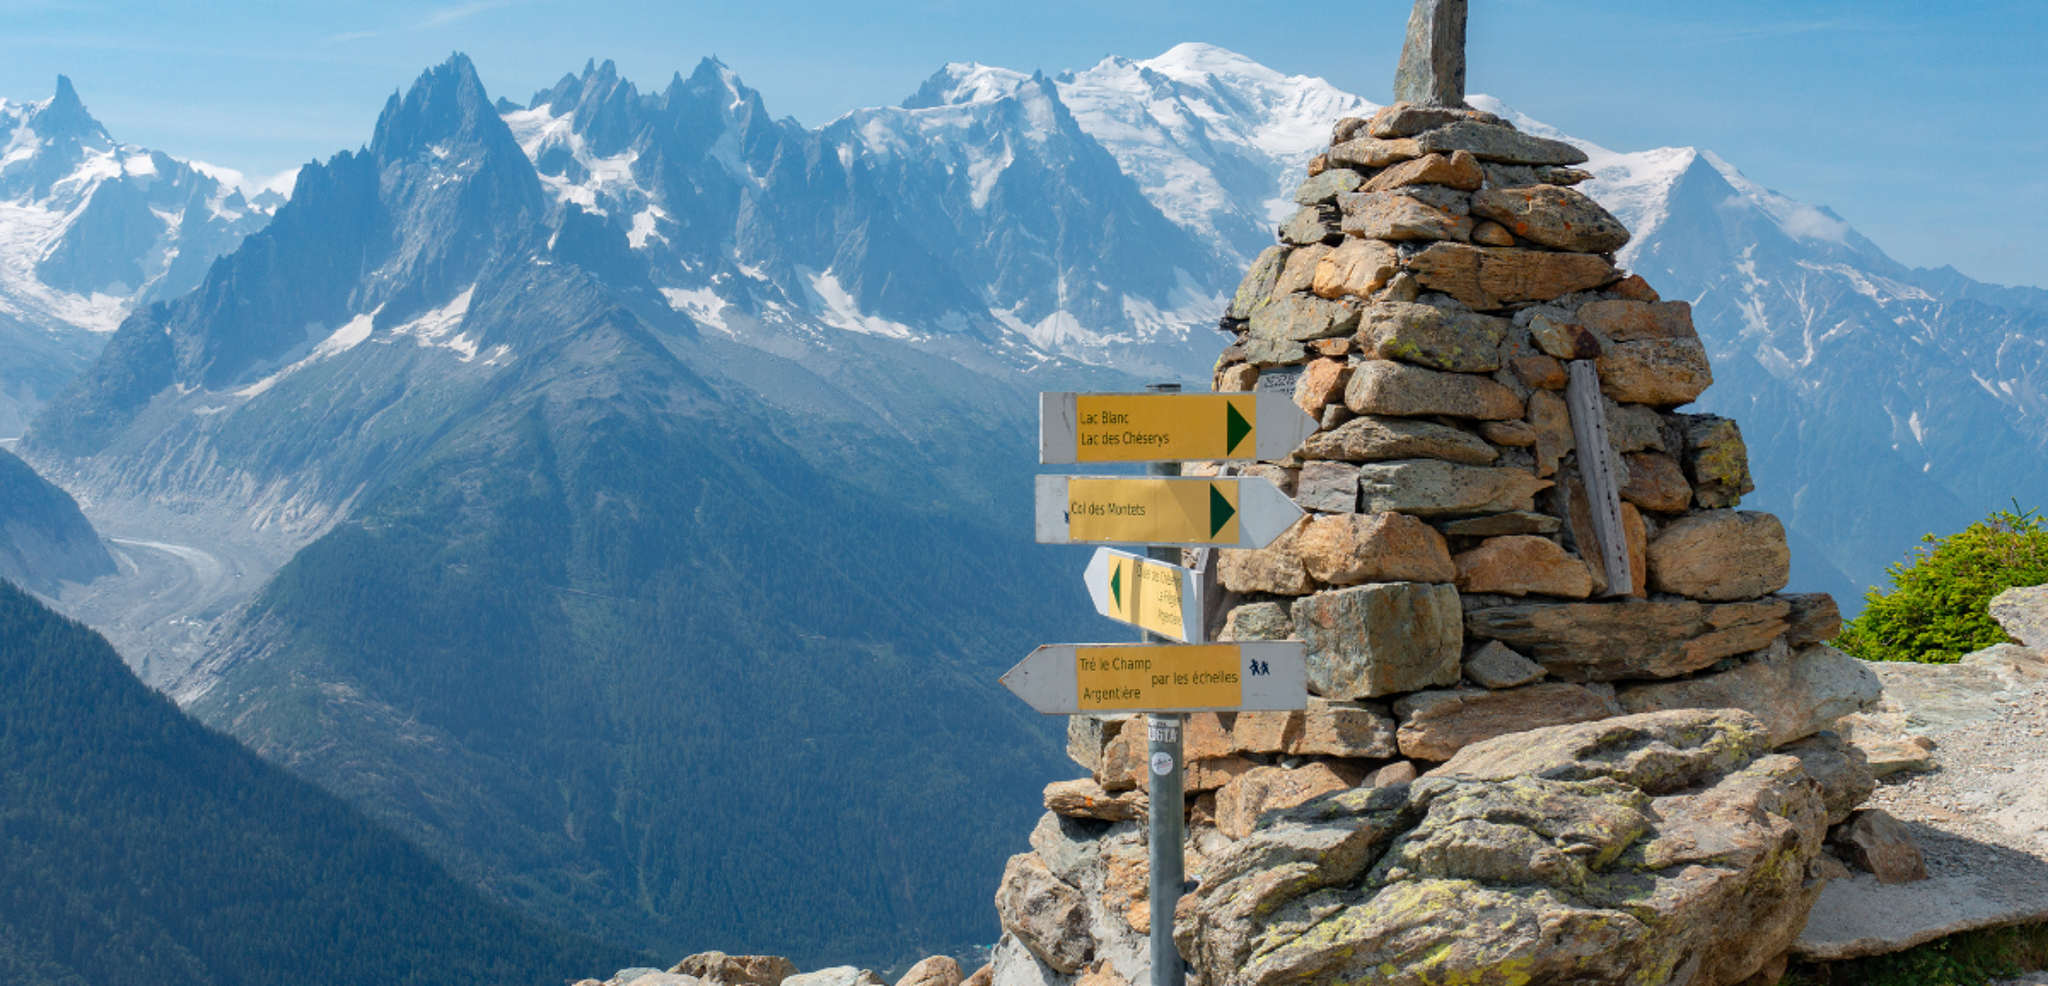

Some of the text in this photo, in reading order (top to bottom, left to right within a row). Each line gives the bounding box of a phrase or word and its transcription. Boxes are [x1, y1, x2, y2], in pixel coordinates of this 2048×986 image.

[1080, 411, 1129, 425] Lac Blanc
[1081, 431, 1169, 448] Lac des Chéserys
[1071, 502, 1146, 516] Col des Montets
[1080, 657, 1152, 673] Tré le Champ
[1151, 669, 1239, 687] par les échelles
[1083, 686, 1141, 702] Argentière
